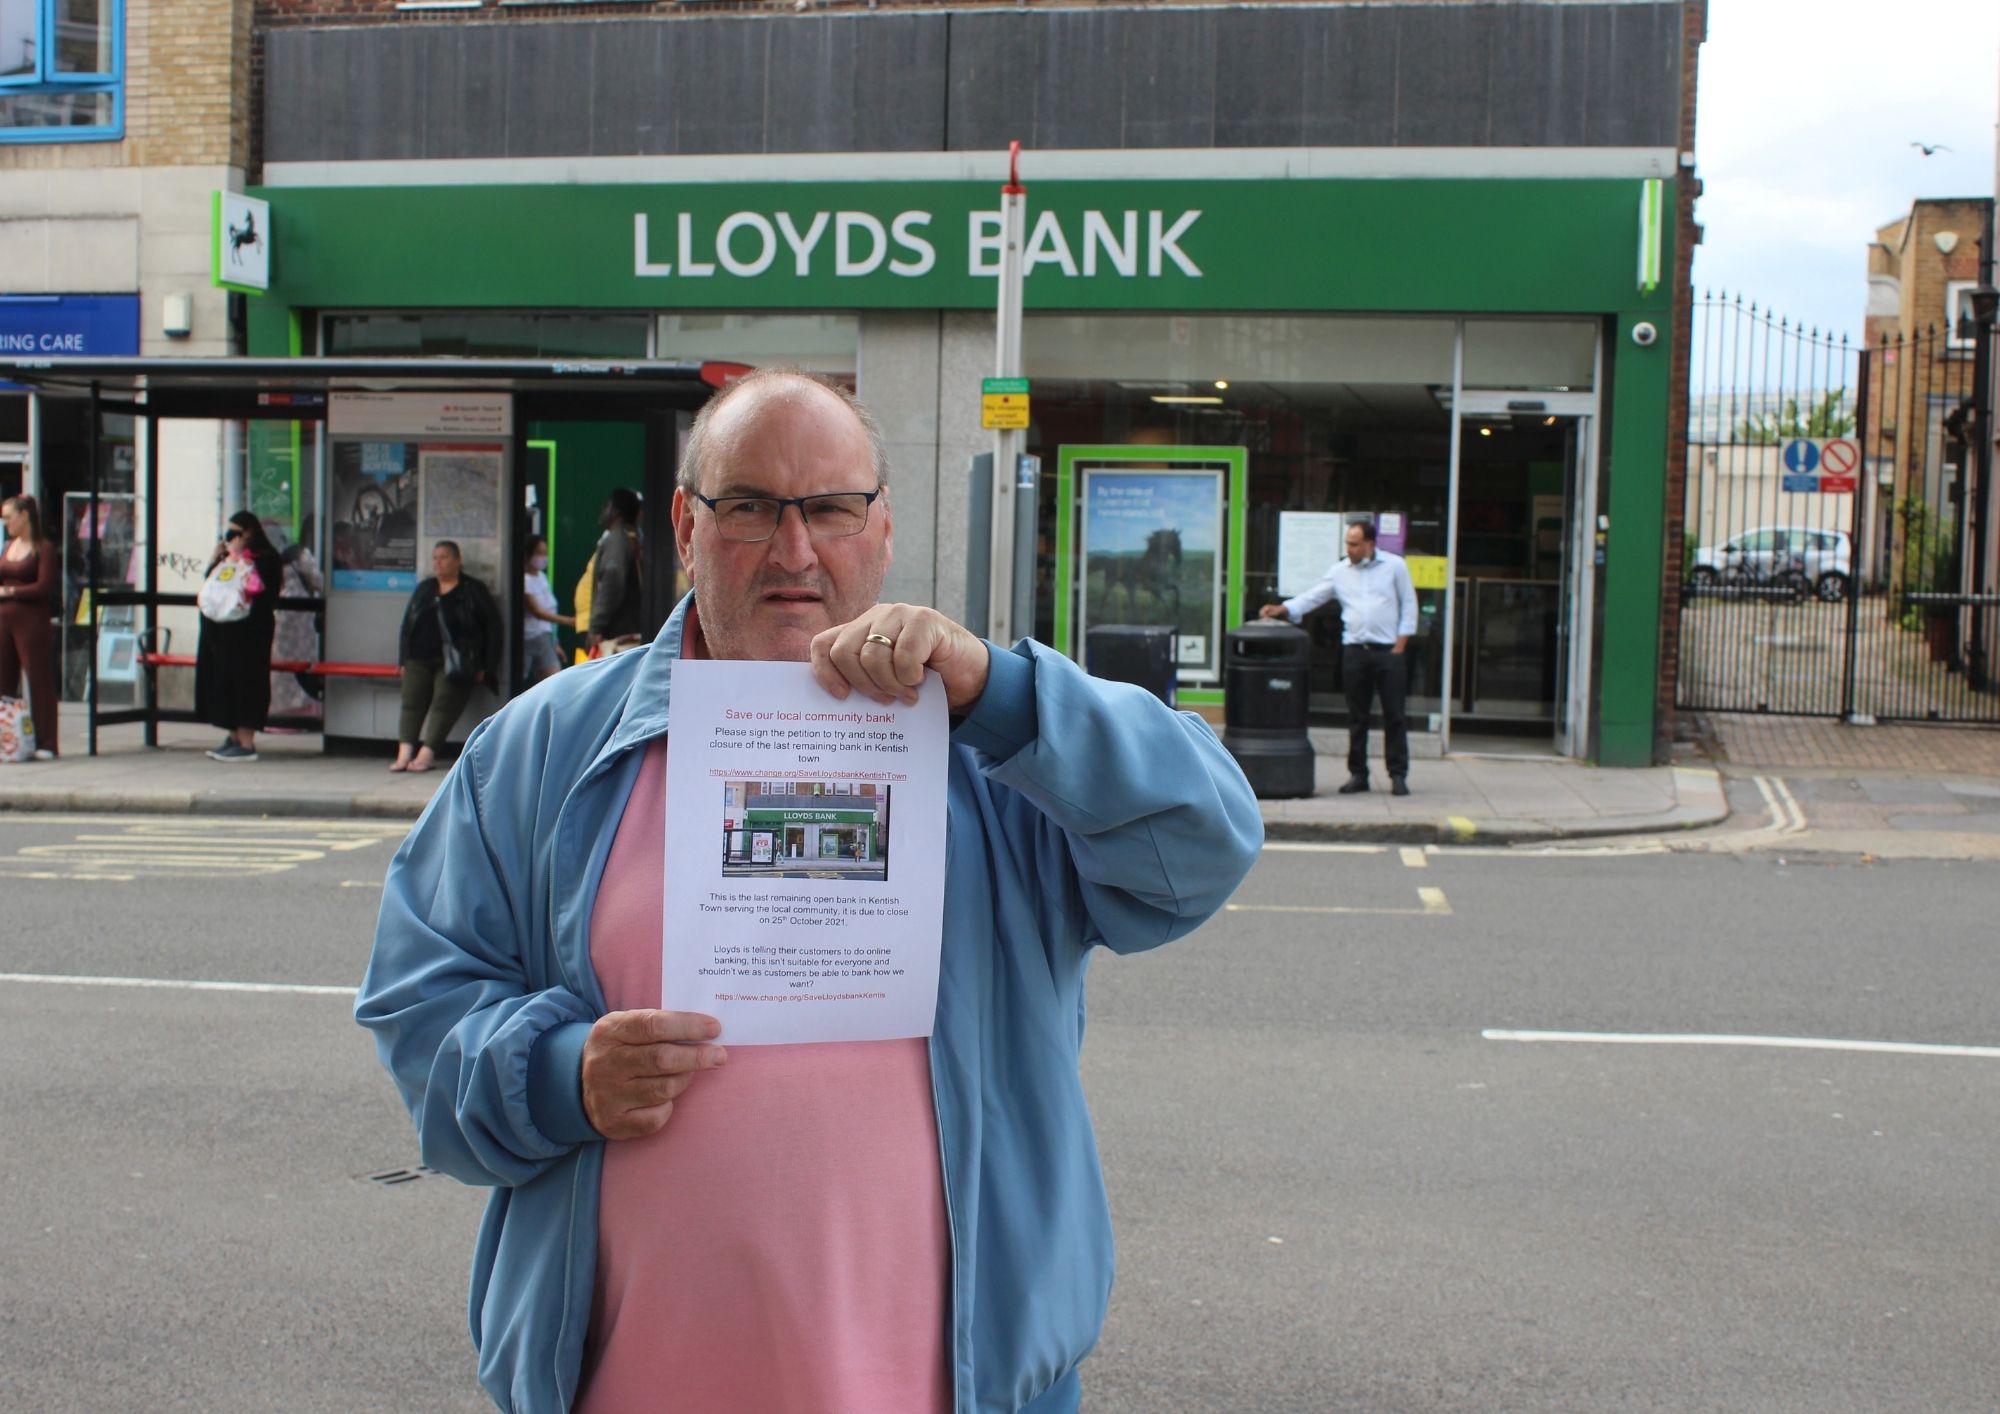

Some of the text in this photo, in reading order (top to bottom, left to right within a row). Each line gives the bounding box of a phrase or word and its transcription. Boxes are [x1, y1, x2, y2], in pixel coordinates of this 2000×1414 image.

[633, 209, 1204, 278] LLOYDS BANK
[40, 334, 84, 351] CARE
[725, 709, 895, 725] Save our local community bank!
[715, 727, 904, 742] Please sign the petition to try and stop the
[709, 739, 909, 753] closure of the last remaining bank in Kentish
[798, 754, 820, 763] town
[784, 812, 837, 820] LLOYDS BANK
[709, 892, 900, 905] This is the last remaining open bank in Kentish
[698, 903, 723, 912] Town
[724, 905, 755, 915] serving
[756, 905, 770, 913] the
[771, 905, 792, 913] local
[792, 906, 841, 917] community,
[842, 907, 848, 915] it
[858, 907, 875, 916] due
[876, 908, 885, 916] to
[886, 908, 909, 916] close
[789, 916, 823, 926] October
[824, 917, 848, 927] 2021.
[714, 945, 741, 955] Lloyds
[742, 945, 750, 954] is
[752, 945, 777, 956] telling
[778, 946, 798, 955] their
[798, 948, 842, 956] customers
[853, 947, 865, 956] do
[866, 947, 892, 955] online
[714, 956, 890, 968] banking, this isn't suitable for everyone and
[698, 967, 736, 976] shouldn't
[764, 969, 807, 977] customers
[821, 969, 840, 977] able
[851, 968, 872, 977] bank
[873, 968, 891, 976] how
[788, 980, 814, 988] want?
